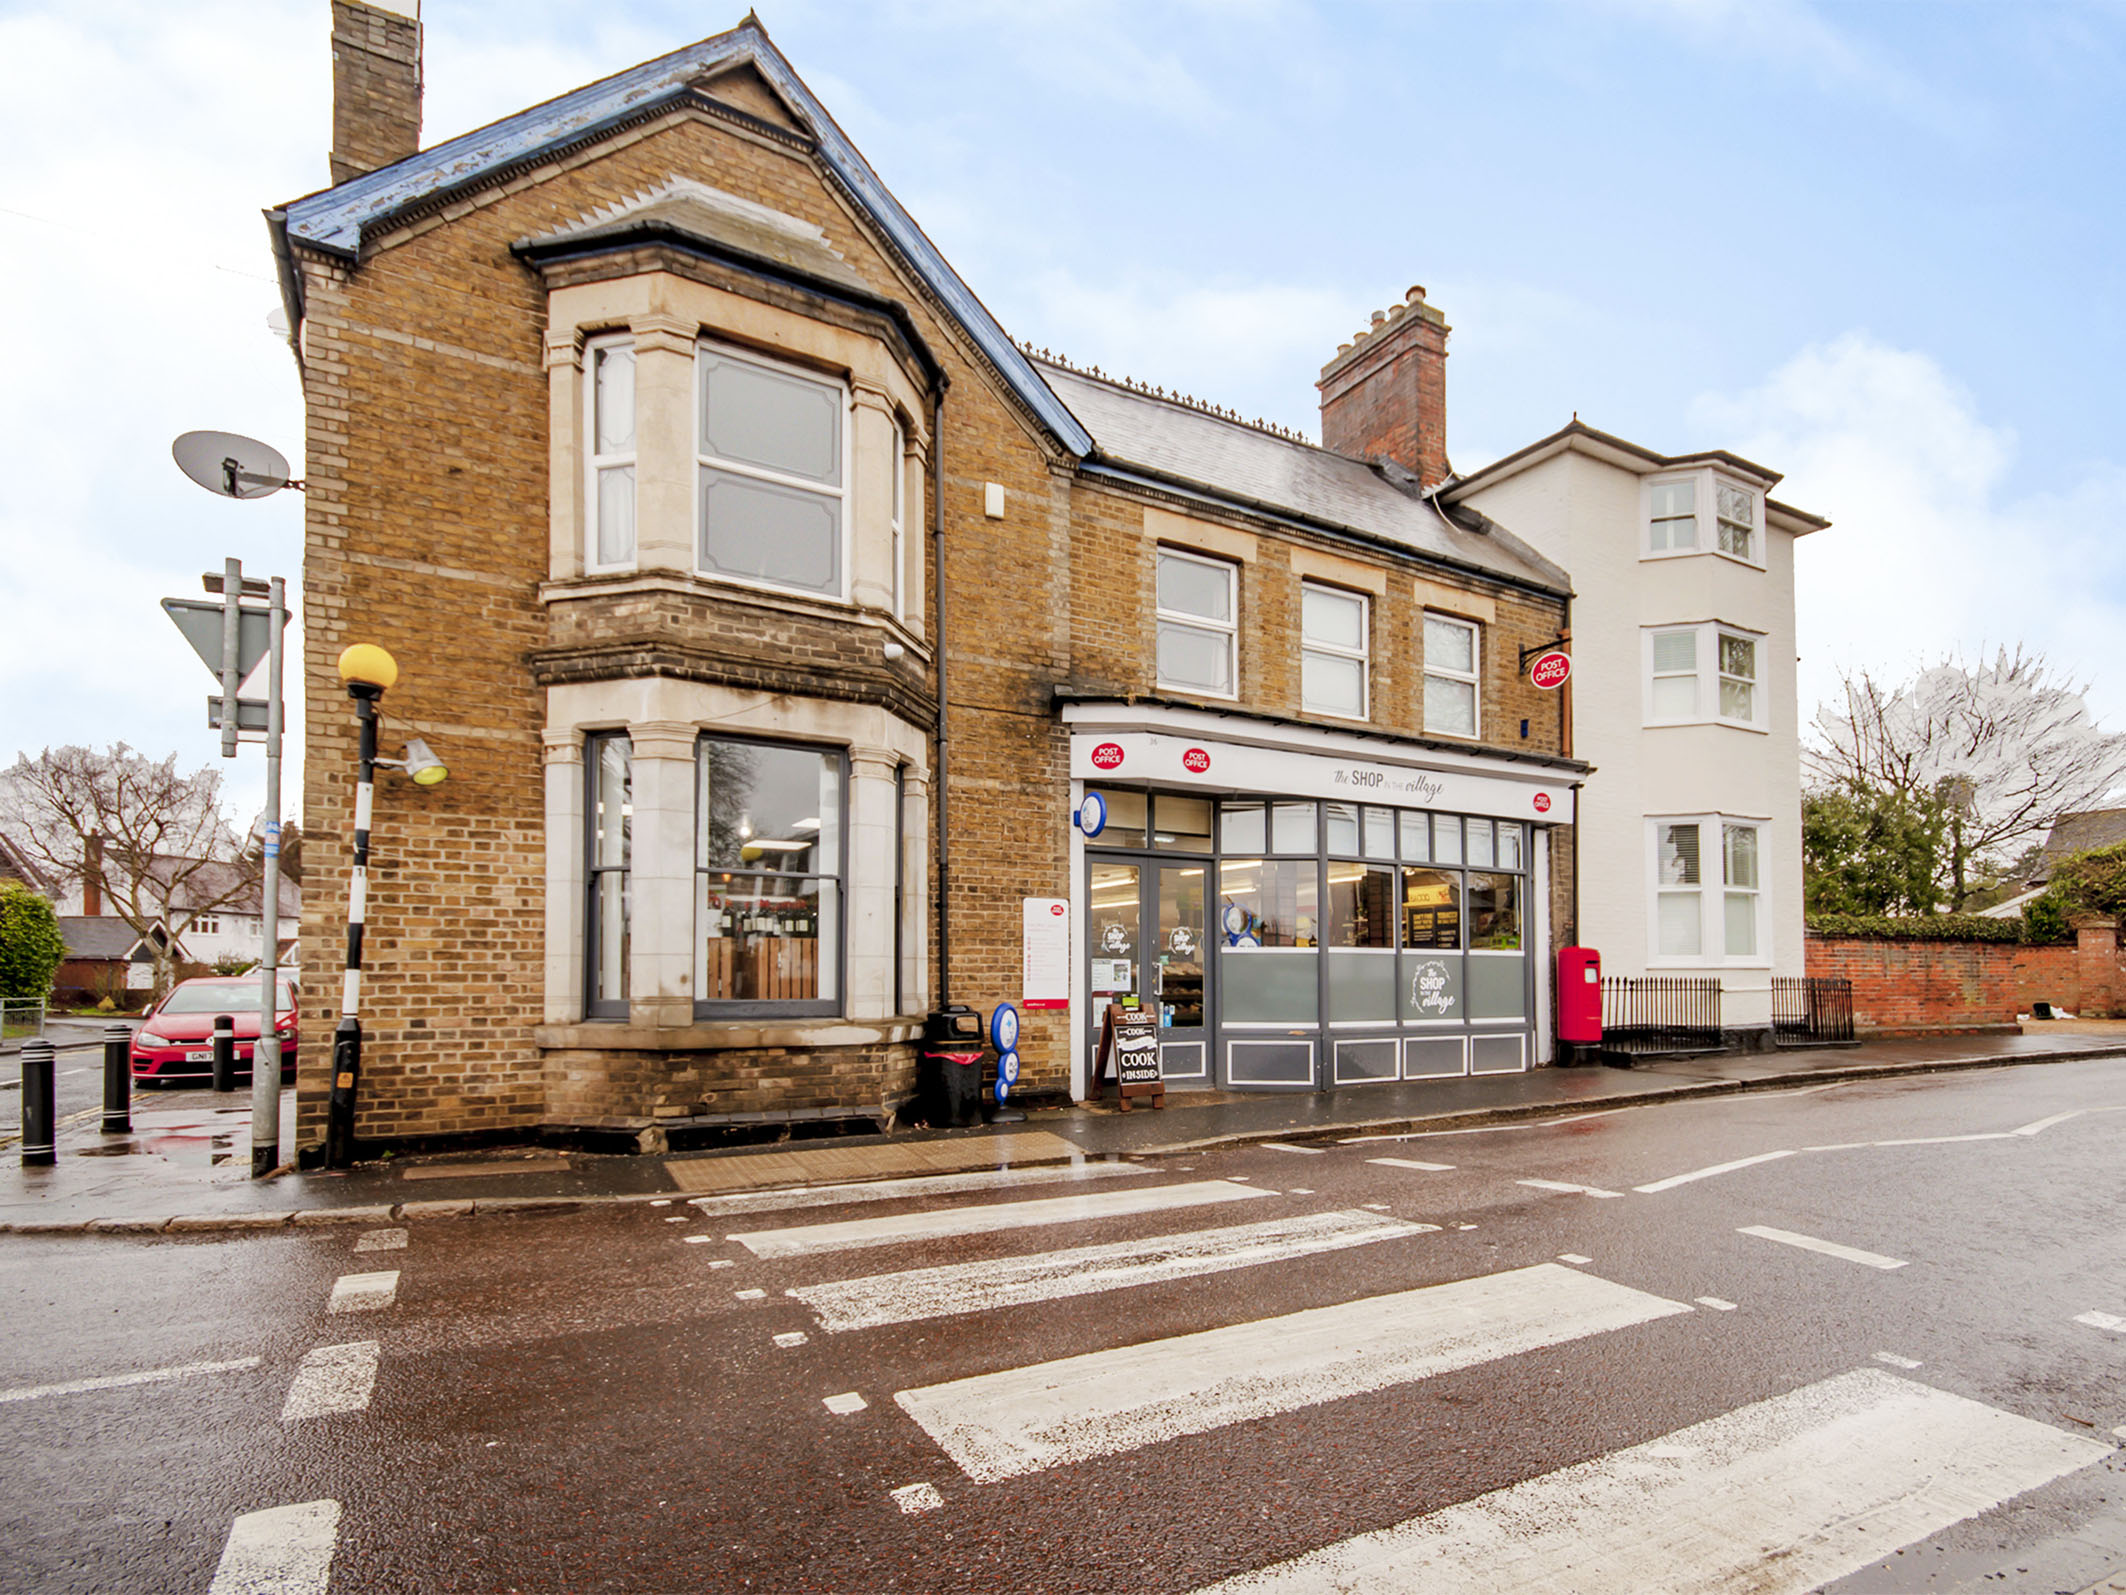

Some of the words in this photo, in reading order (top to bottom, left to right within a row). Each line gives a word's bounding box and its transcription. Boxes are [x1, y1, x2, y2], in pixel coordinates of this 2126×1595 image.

[1541, 658, 1563, 671] POST
[1536, 667, 1566, 682] OFFICE
[1099, 747, 1119, 756] POST
[1189, 752, 1206, 761] POST
[1093, 755, 1121, 764] OFFICE
[1184, 759, 1208, 769] OFFICE
[1351, 769, 1384, 788] SHOP
[1405, 775, 1443, 803] village
[1420, 977, 1446, 990] SHOP
[1422, 990, 1456, 1015] village
[1126, 1012, 1147, 1022] COOK
[1126, 1027, 1145, 1036] COOK
[1121, 1052, 1156, 1067] COOK
[1126, 1069, 1155, 1080] INSIDE
